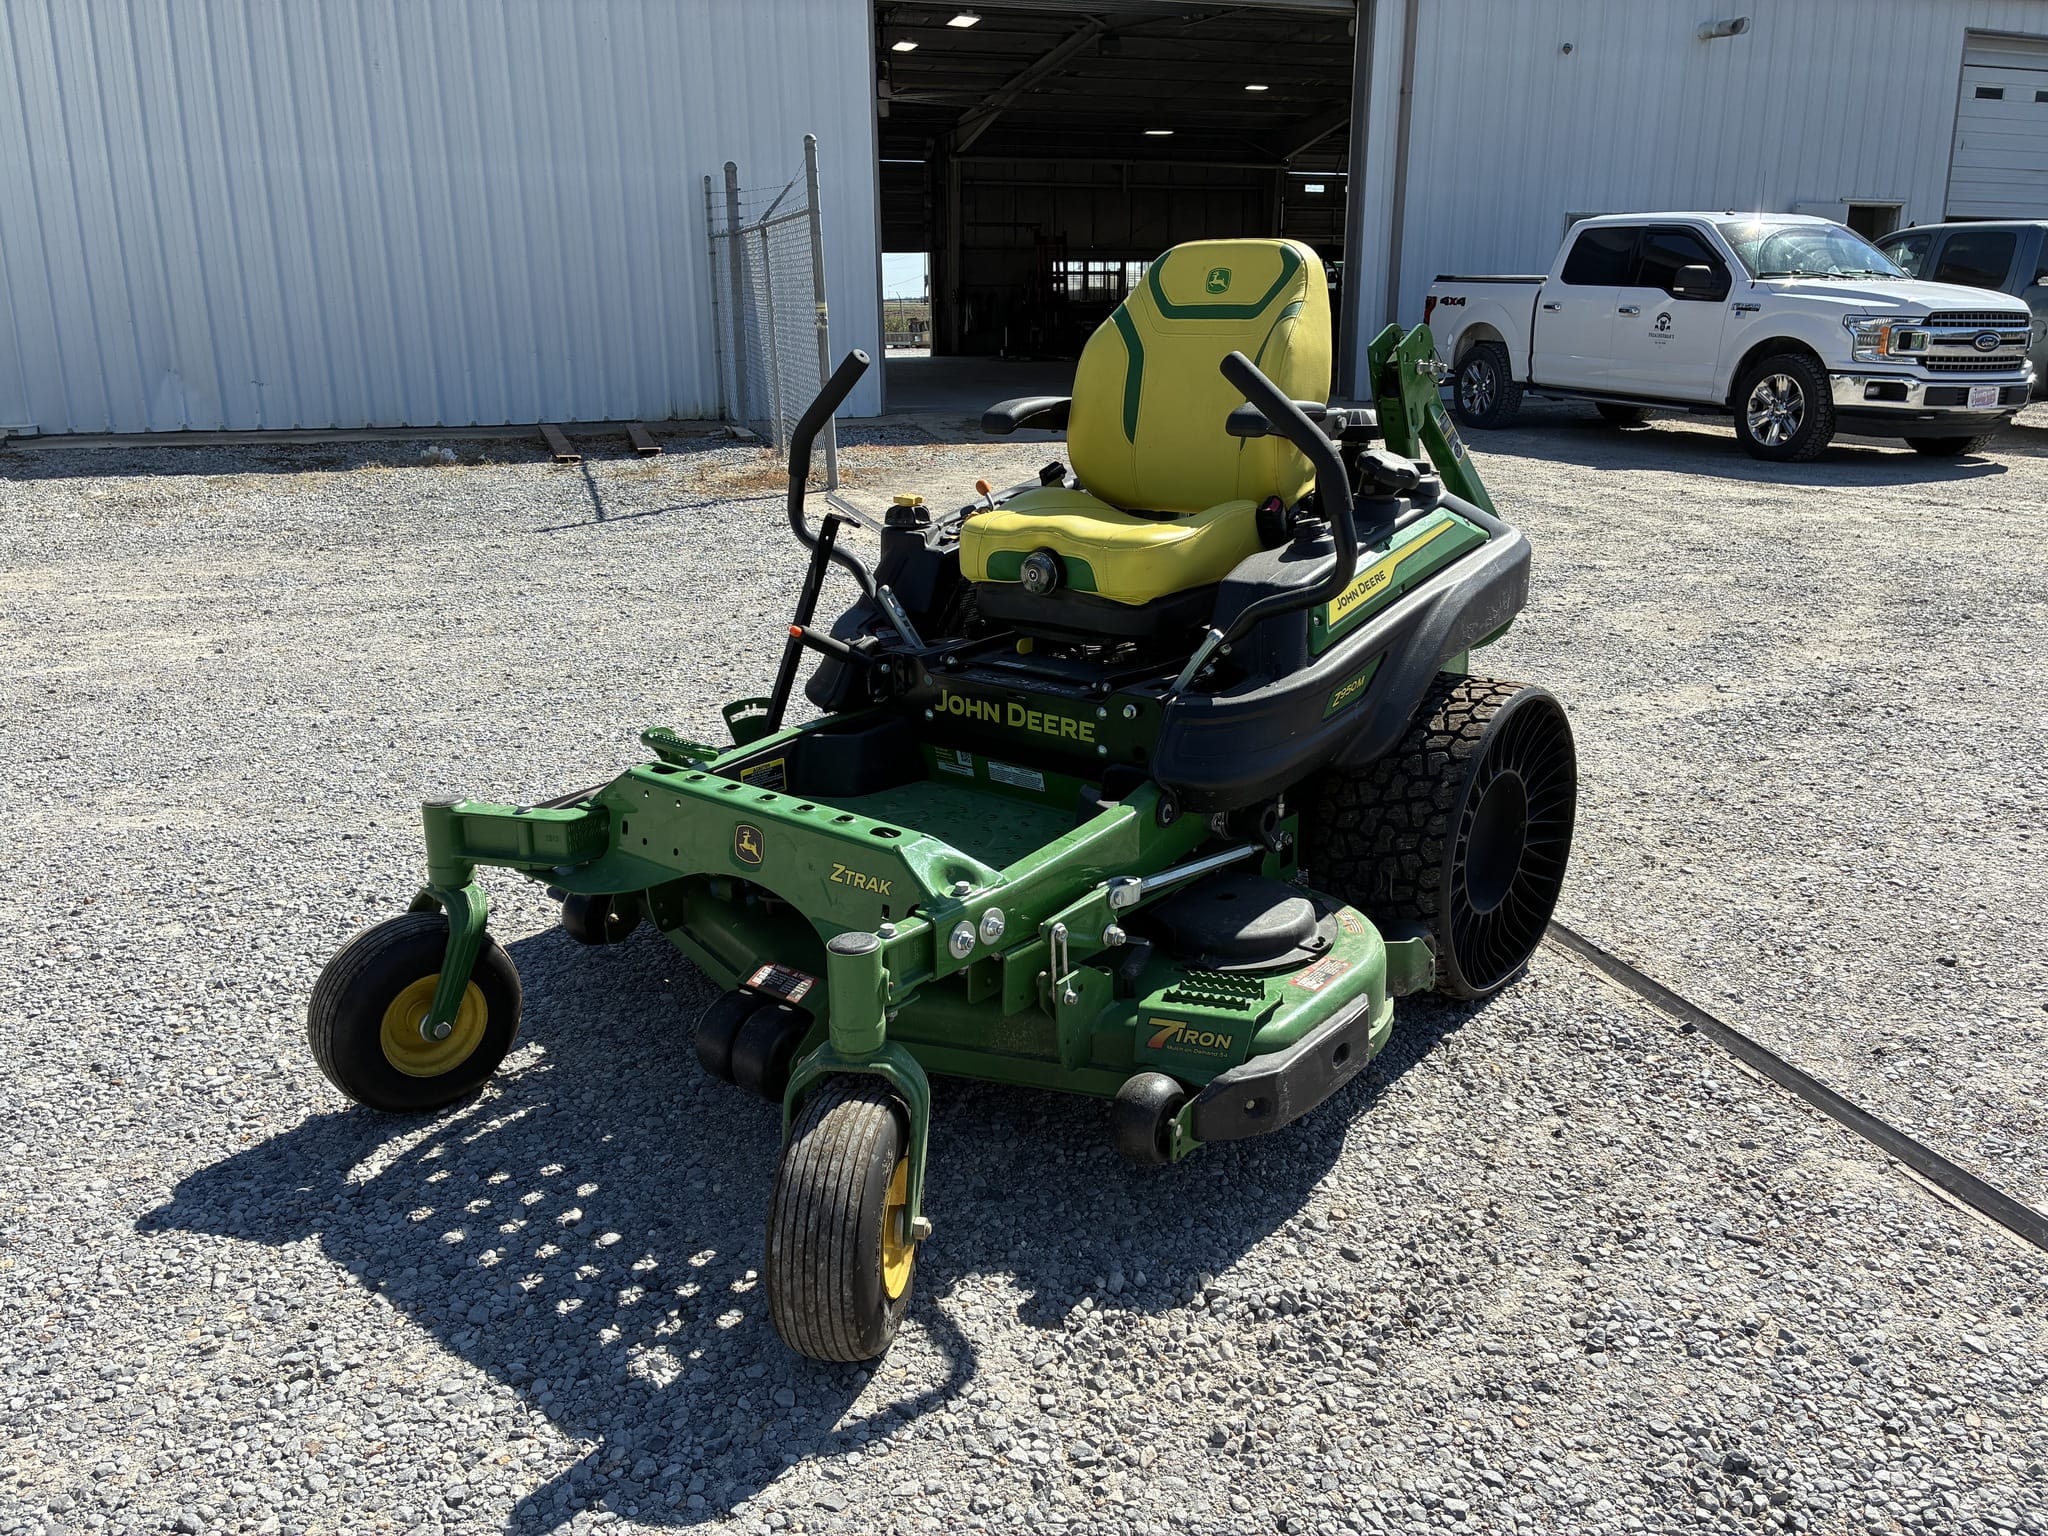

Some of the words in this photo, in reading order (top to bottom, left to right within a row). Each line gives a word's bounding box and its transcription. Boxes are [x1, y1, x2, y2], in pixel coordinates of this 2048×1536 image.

[1337, 588, 1358, 610] JOHN
[1358, 570, 1386, 595] DEERE
[1332, 675, 1366, 708] Z950M
[934, 689, 1000, 723] JOHN
[1007, 702, 1096, 743] DEERE
[829, 863, 894, 896] ZTRAK
